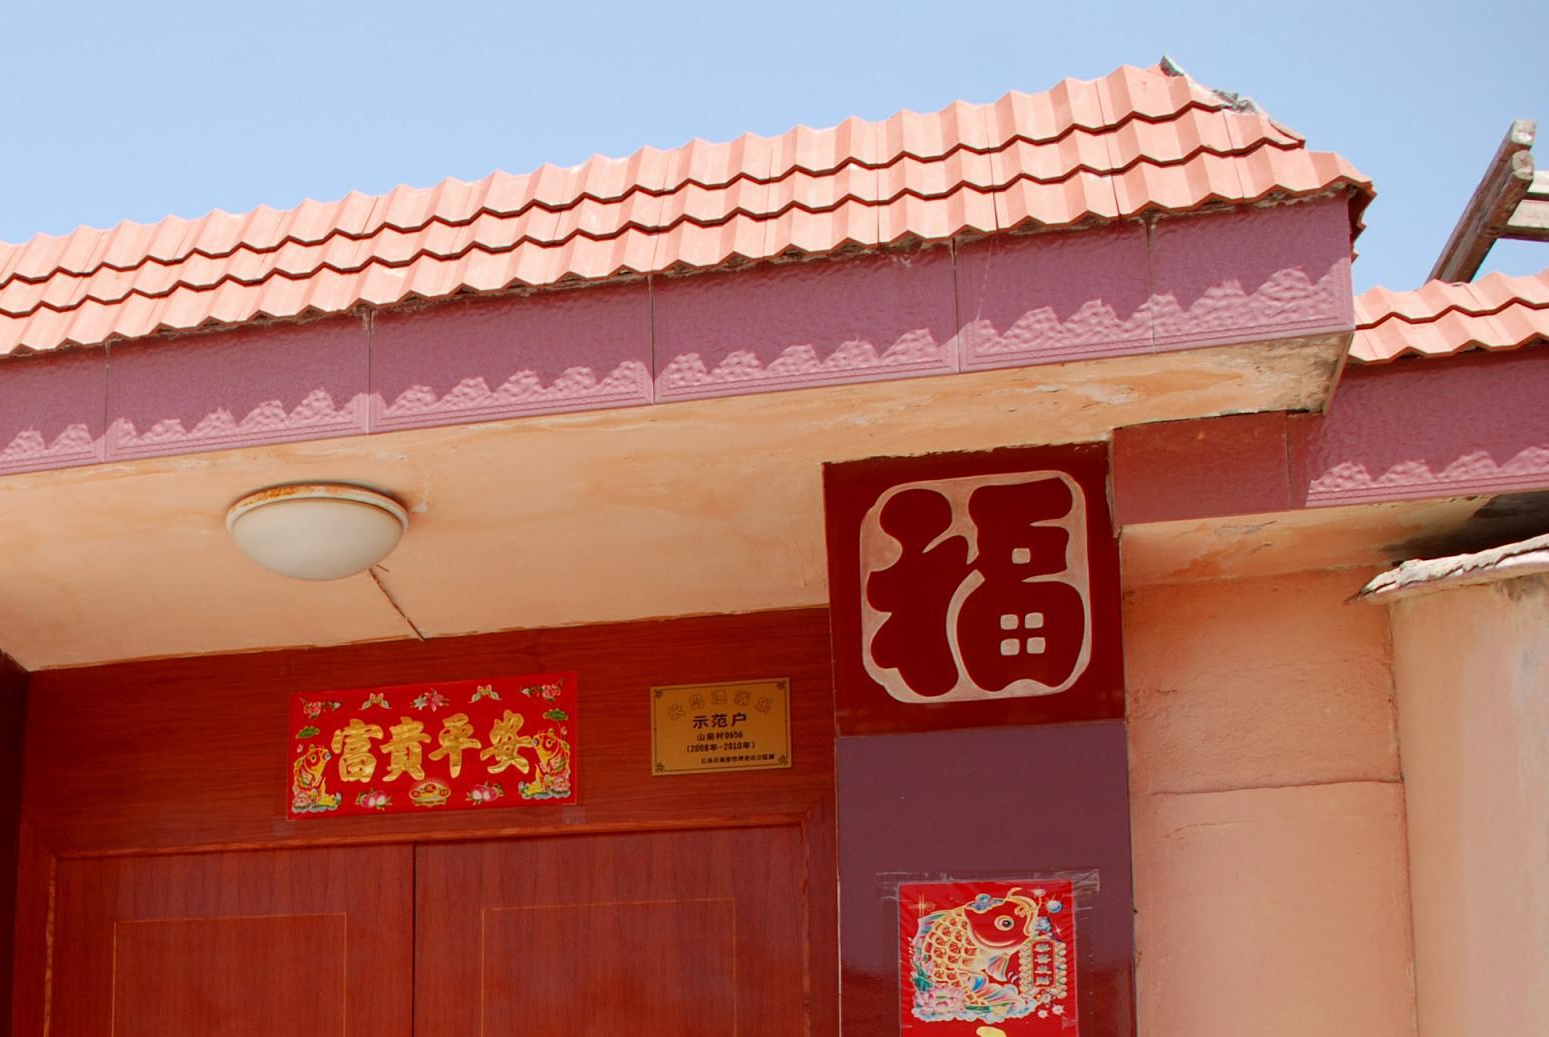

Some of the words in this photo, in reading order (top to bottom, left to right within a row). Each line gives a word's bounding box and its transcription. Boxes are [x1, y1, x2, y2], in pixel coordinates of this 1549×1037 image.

[860, 470, 1092, 704] 福
[331, 709, 534, 783] 富貴平安
[693, 712, 747, 729] 示范户
